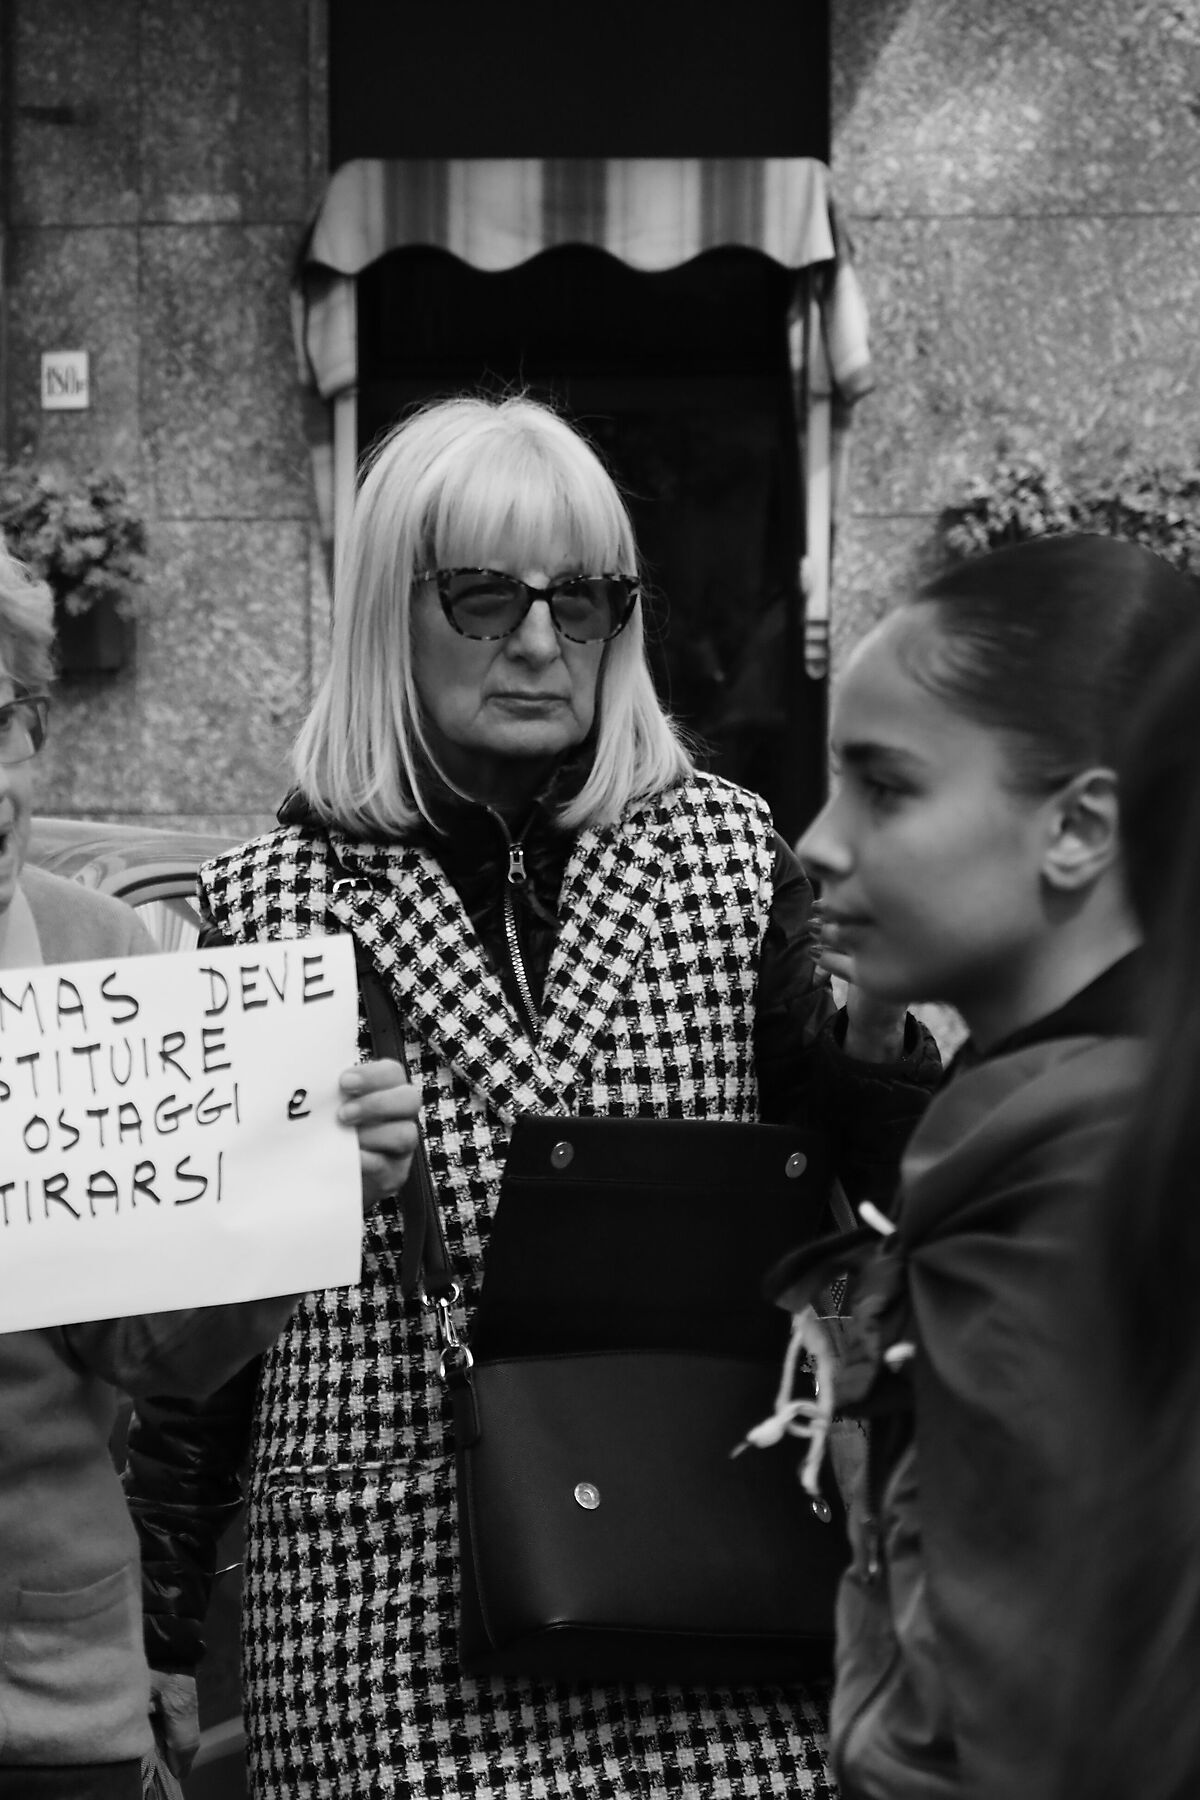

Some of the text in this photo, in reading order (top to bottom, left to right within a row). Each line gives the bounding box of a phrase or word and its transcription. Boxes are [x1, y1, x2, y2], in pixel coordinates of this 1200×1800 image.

[198, 952, 335, 1018] DEVE
[22, 1081, 241, 1154] OSTAGGI
[286, 1087, 313, 1121] e
